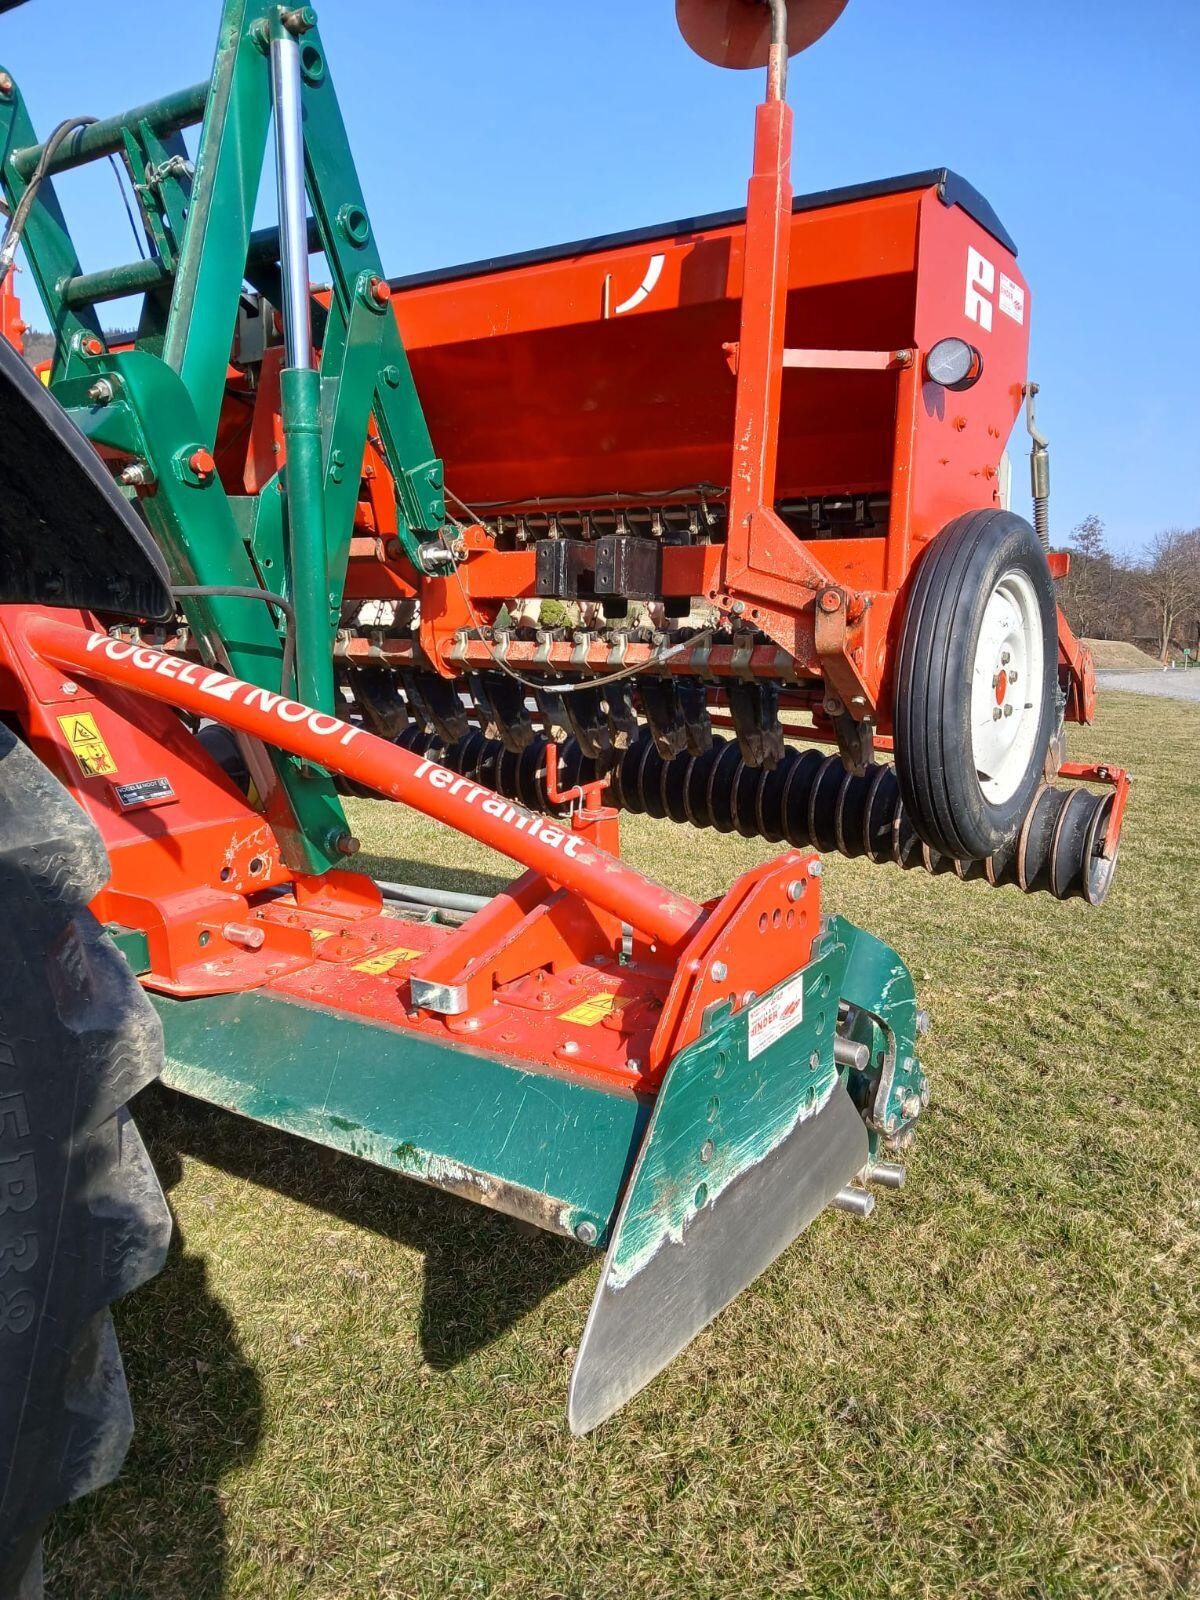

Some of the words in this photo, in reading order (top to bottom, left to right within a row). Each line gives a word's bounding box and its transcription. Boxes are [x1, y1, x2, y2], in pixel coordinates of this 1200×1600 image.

[86, 632, 201, 684] VOGEL
[243, 688, 367, 746] NOOT
[142, 780, 158, 788] NOOT
[413, 759, 586, 858] Terramat
